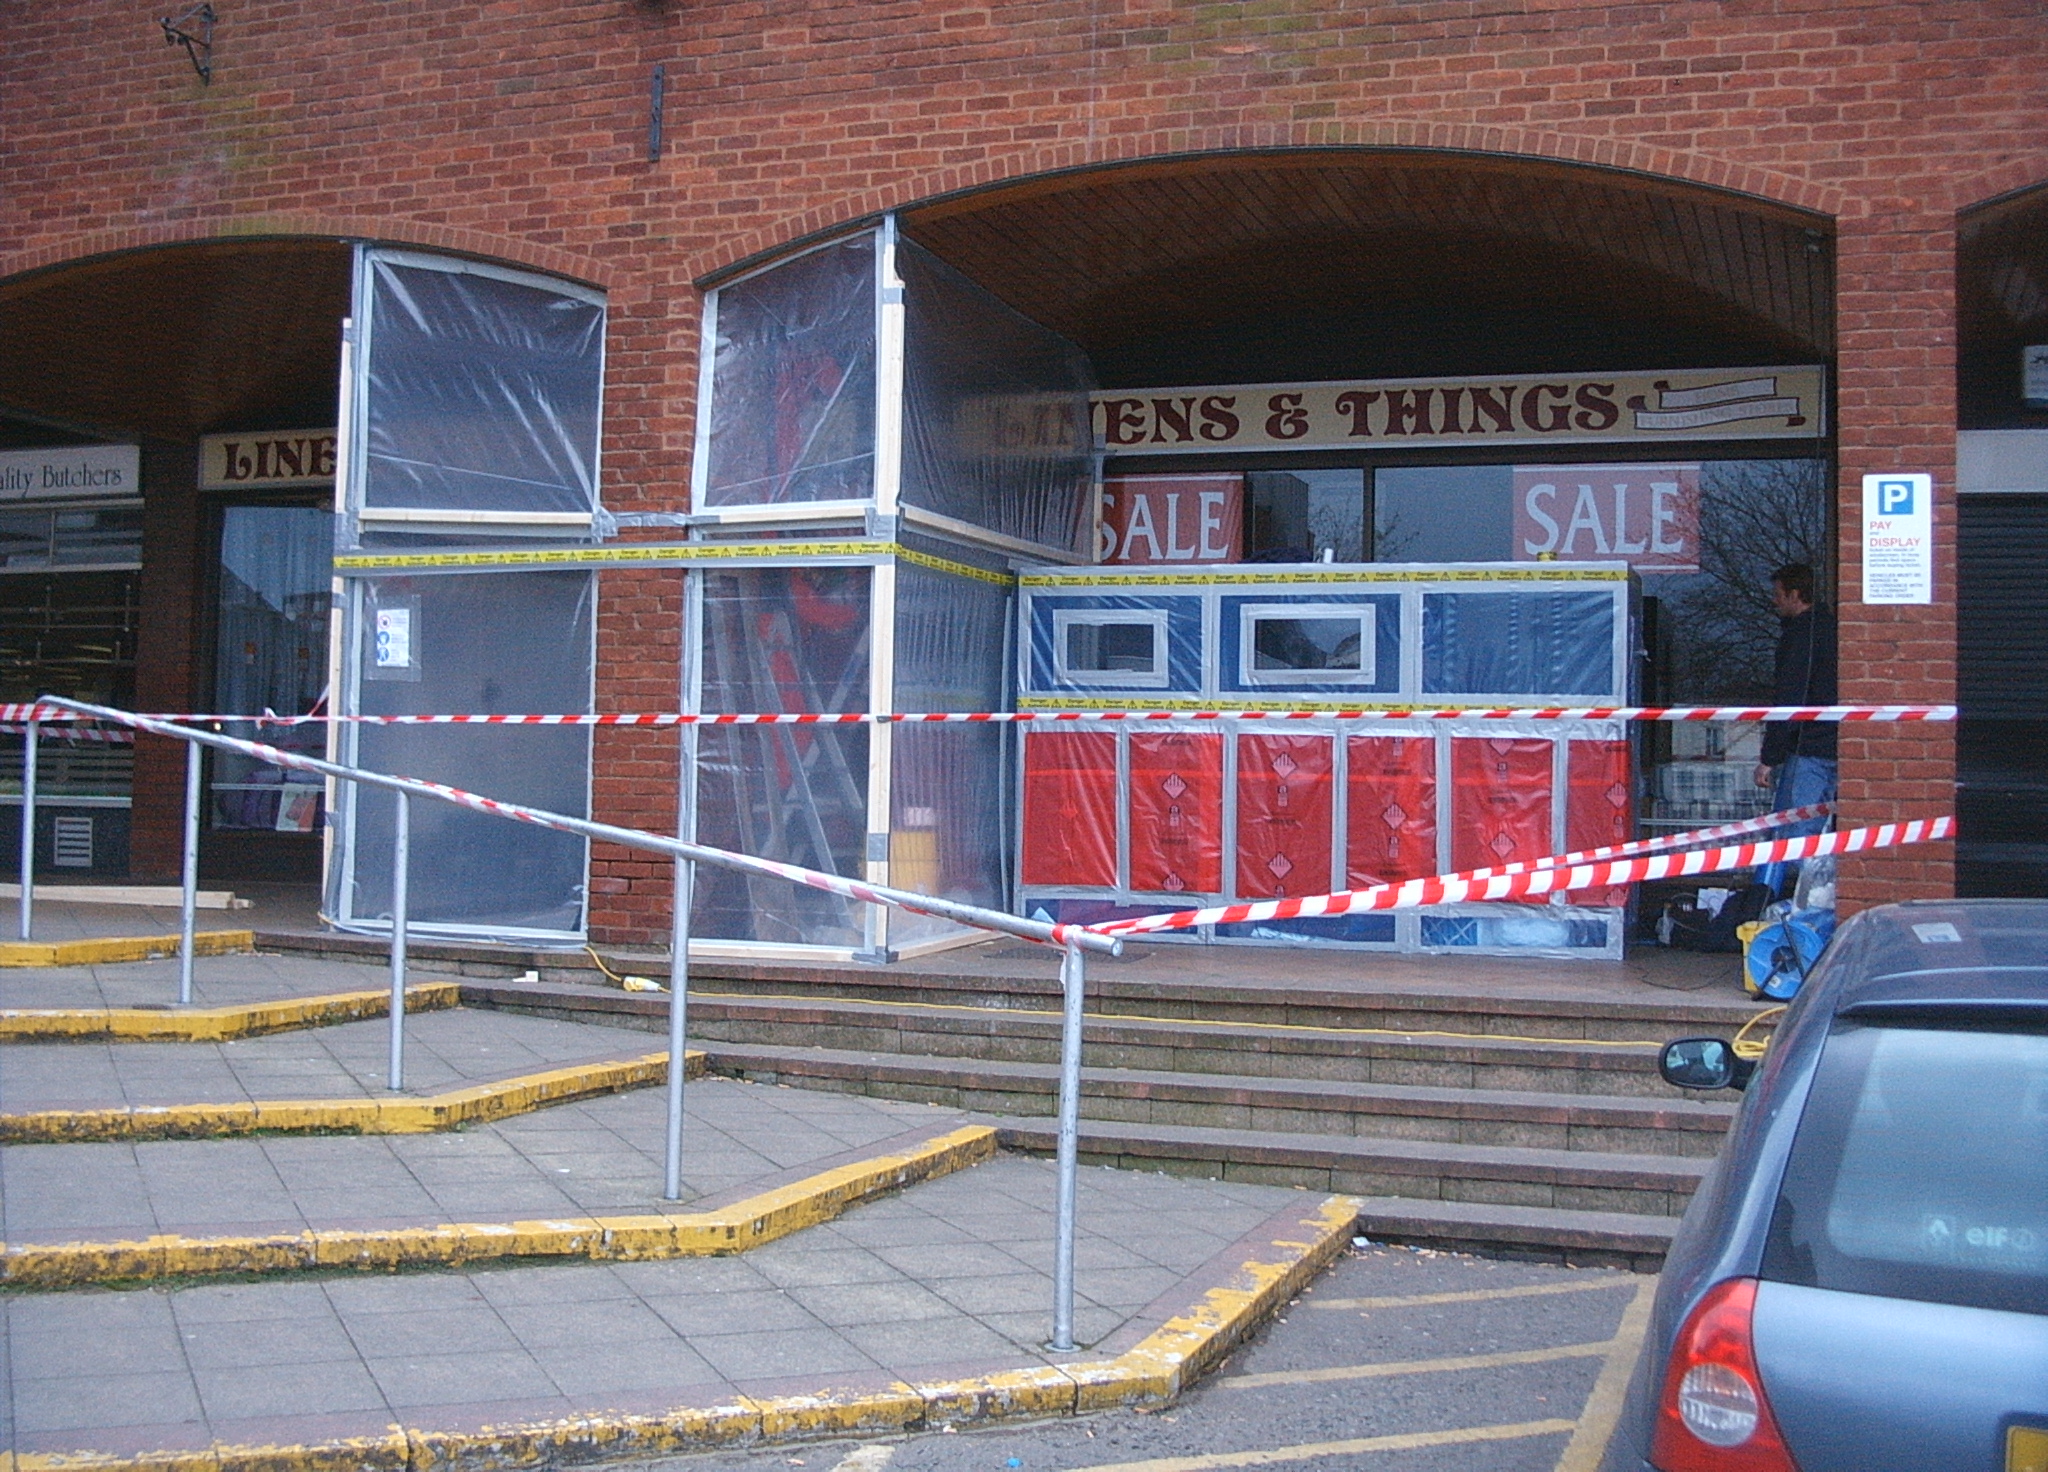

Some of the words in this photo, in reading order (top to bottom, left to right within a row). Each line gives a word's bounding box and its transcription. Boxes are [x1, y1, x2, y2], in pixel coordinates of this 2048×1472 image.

[1265, 392, 1309, 440] &
[1335, 383, 1619, 438] THINGS
[42, 462, 122, 490] Butchers
[1524, 482, 1684, 556] SALE
[1869, 521, 1892, 530] PAY
[1869, 537, 1921, 547] DISPLAY
[1965, 1226, 2007, 1247] elf
